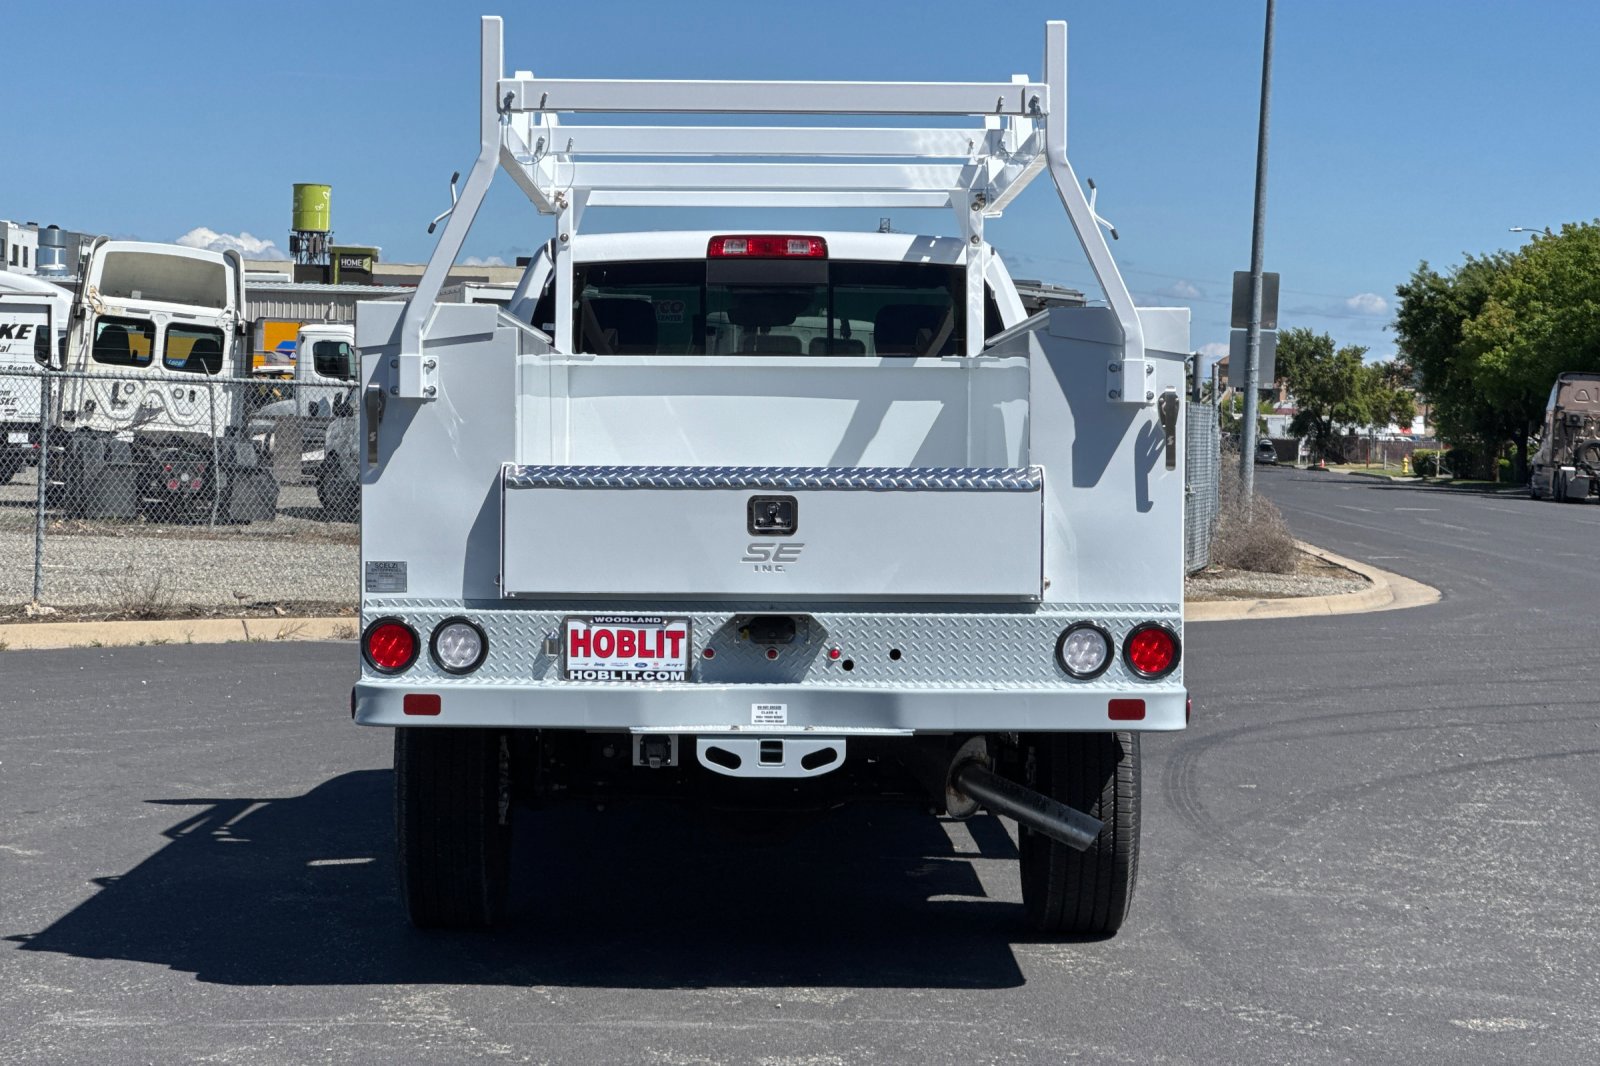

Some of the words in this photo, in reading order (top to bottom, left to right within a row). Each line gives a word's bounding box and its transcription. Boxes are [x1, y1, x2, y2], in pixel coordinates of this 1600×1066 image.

[341, 258, 363, 266] HOME
[740, 543, 805, 563] SE
[593, 616, 662, 624] WOODLAND
[570, 628, 686, 659] HOBLIT
[569, 670, 686, 681] HOBLIT.COM
